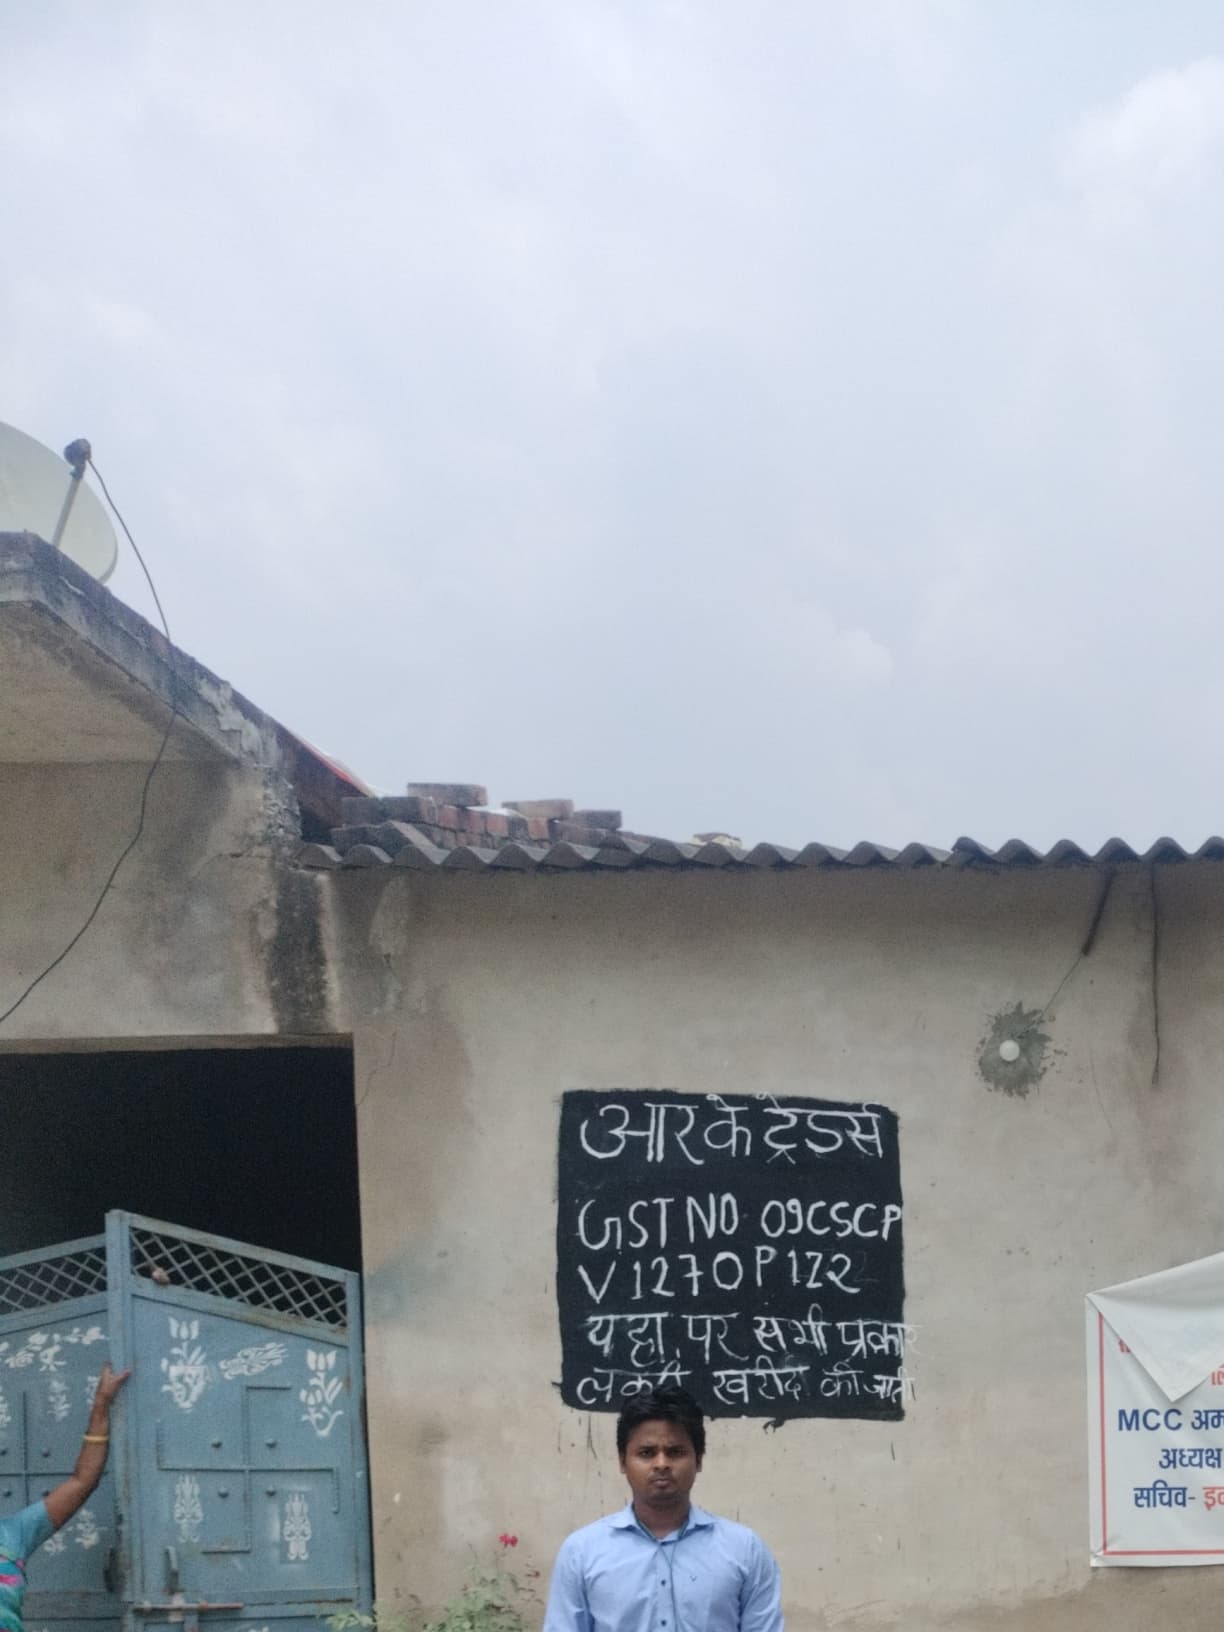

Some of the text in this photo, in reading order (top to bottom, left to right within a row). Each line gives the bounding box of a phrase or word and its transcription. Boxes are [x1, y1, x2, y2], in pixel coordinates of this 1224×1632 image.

[578, 1198, 675, 1250] GST
[686, 1193, 738, 1244] NO
[1117, 1408, 1182, 1431] MCC
[1158, 1447, 1223, 1470] अध्यक्ष
